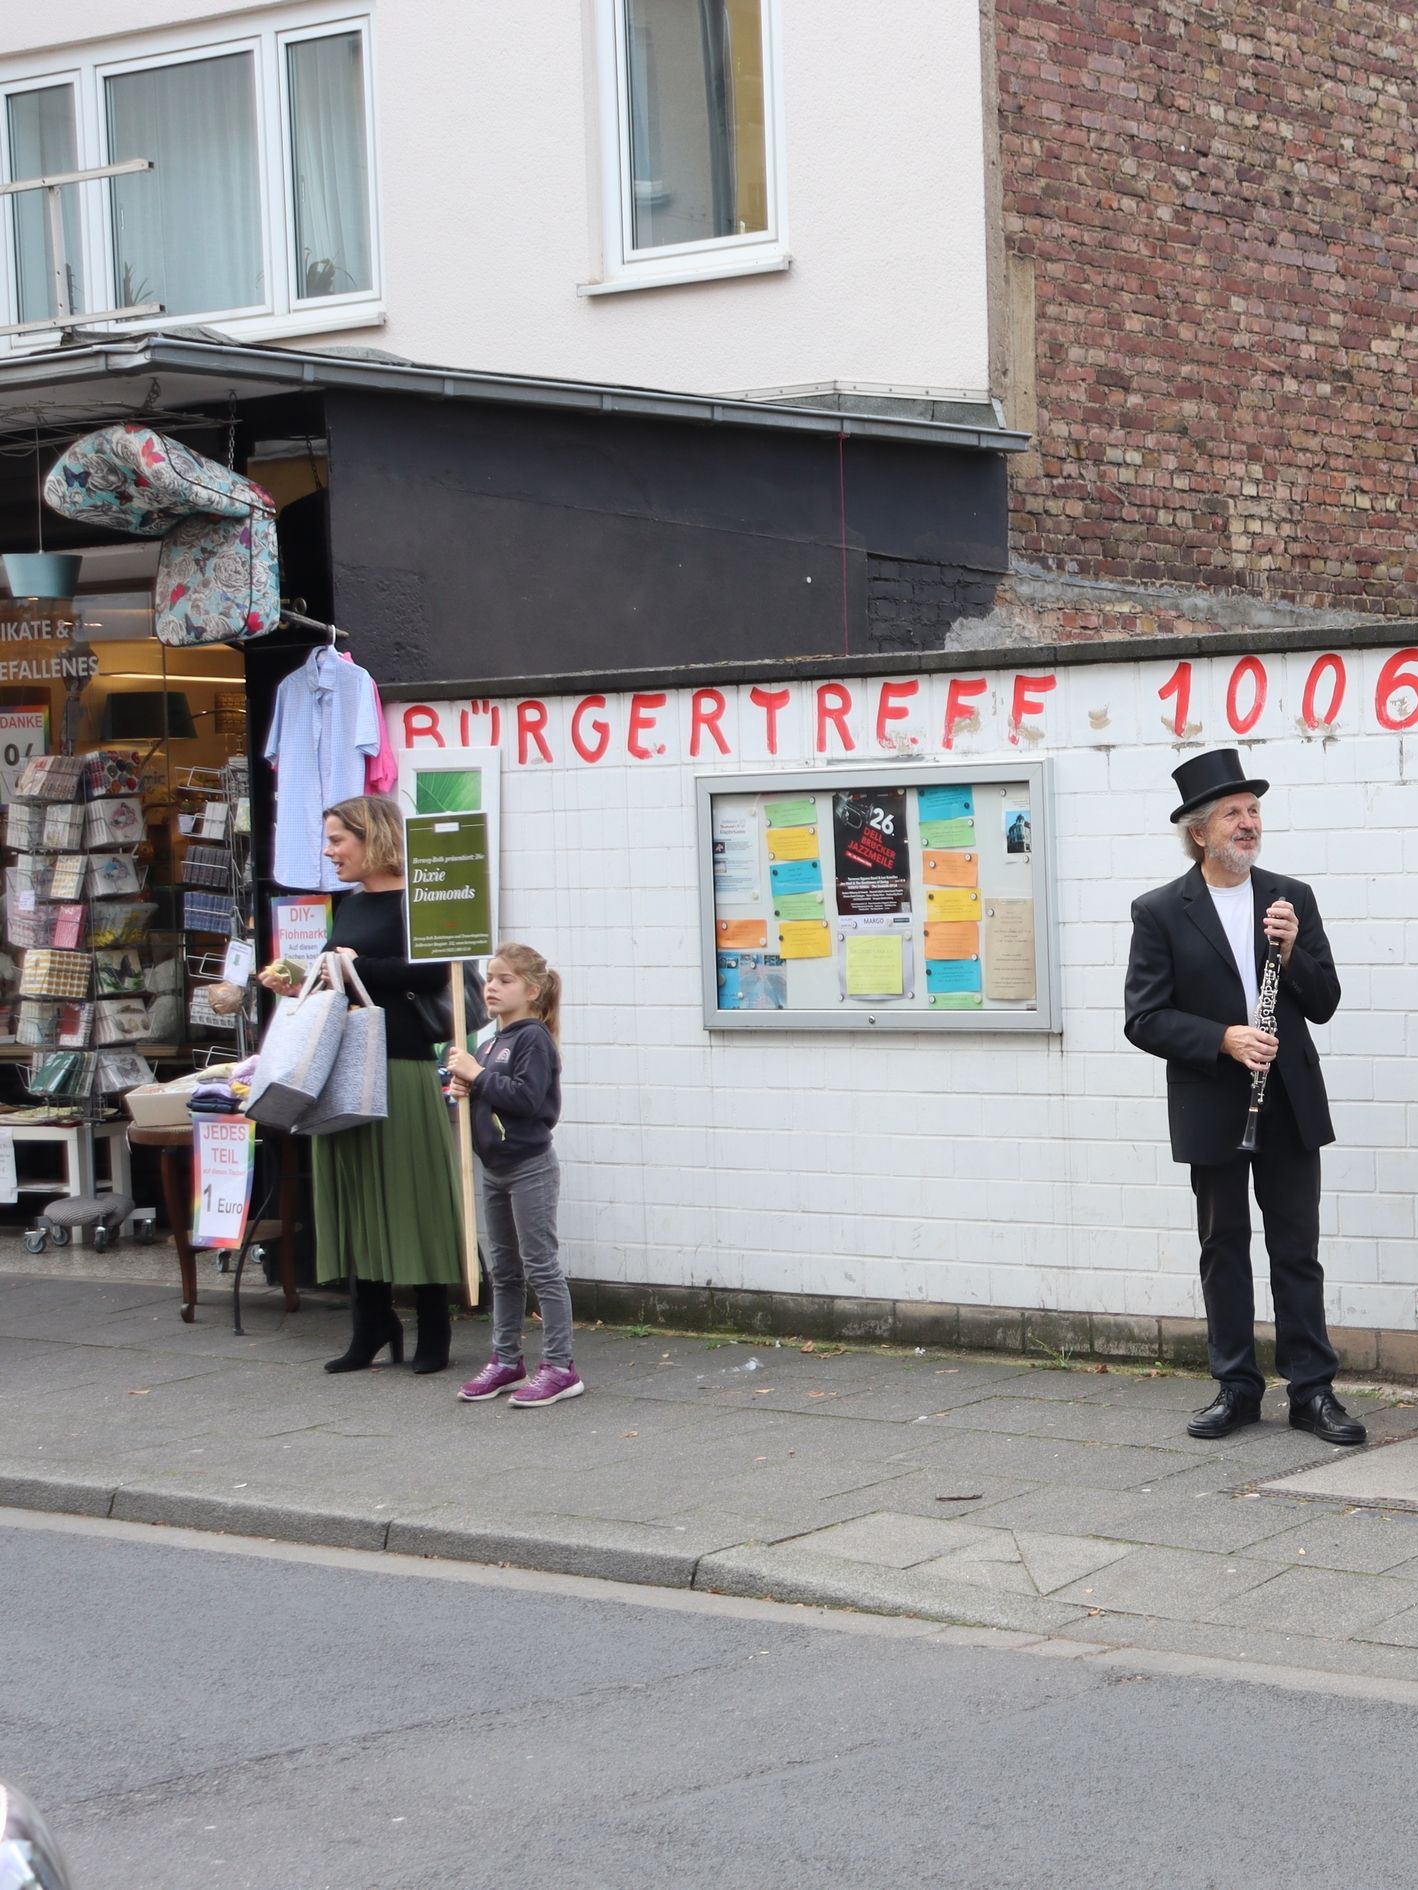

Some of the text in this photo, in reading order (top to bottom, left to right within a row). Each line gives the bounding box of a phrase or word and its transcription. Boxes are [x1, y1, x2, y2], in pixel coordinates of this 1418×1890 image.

[412, 867, 447, 884] Dixie
[412, 884, 476, 903] Diamonds
[289, 907, 316, 922] DIY-
[280, 927, 328, 940] Flohmarkt
[203, 1125, 247, 1142] JEDES
[211, 1147, 239, 1164] TEIL
[203, 1183, 243, 1215] 1 Euro
